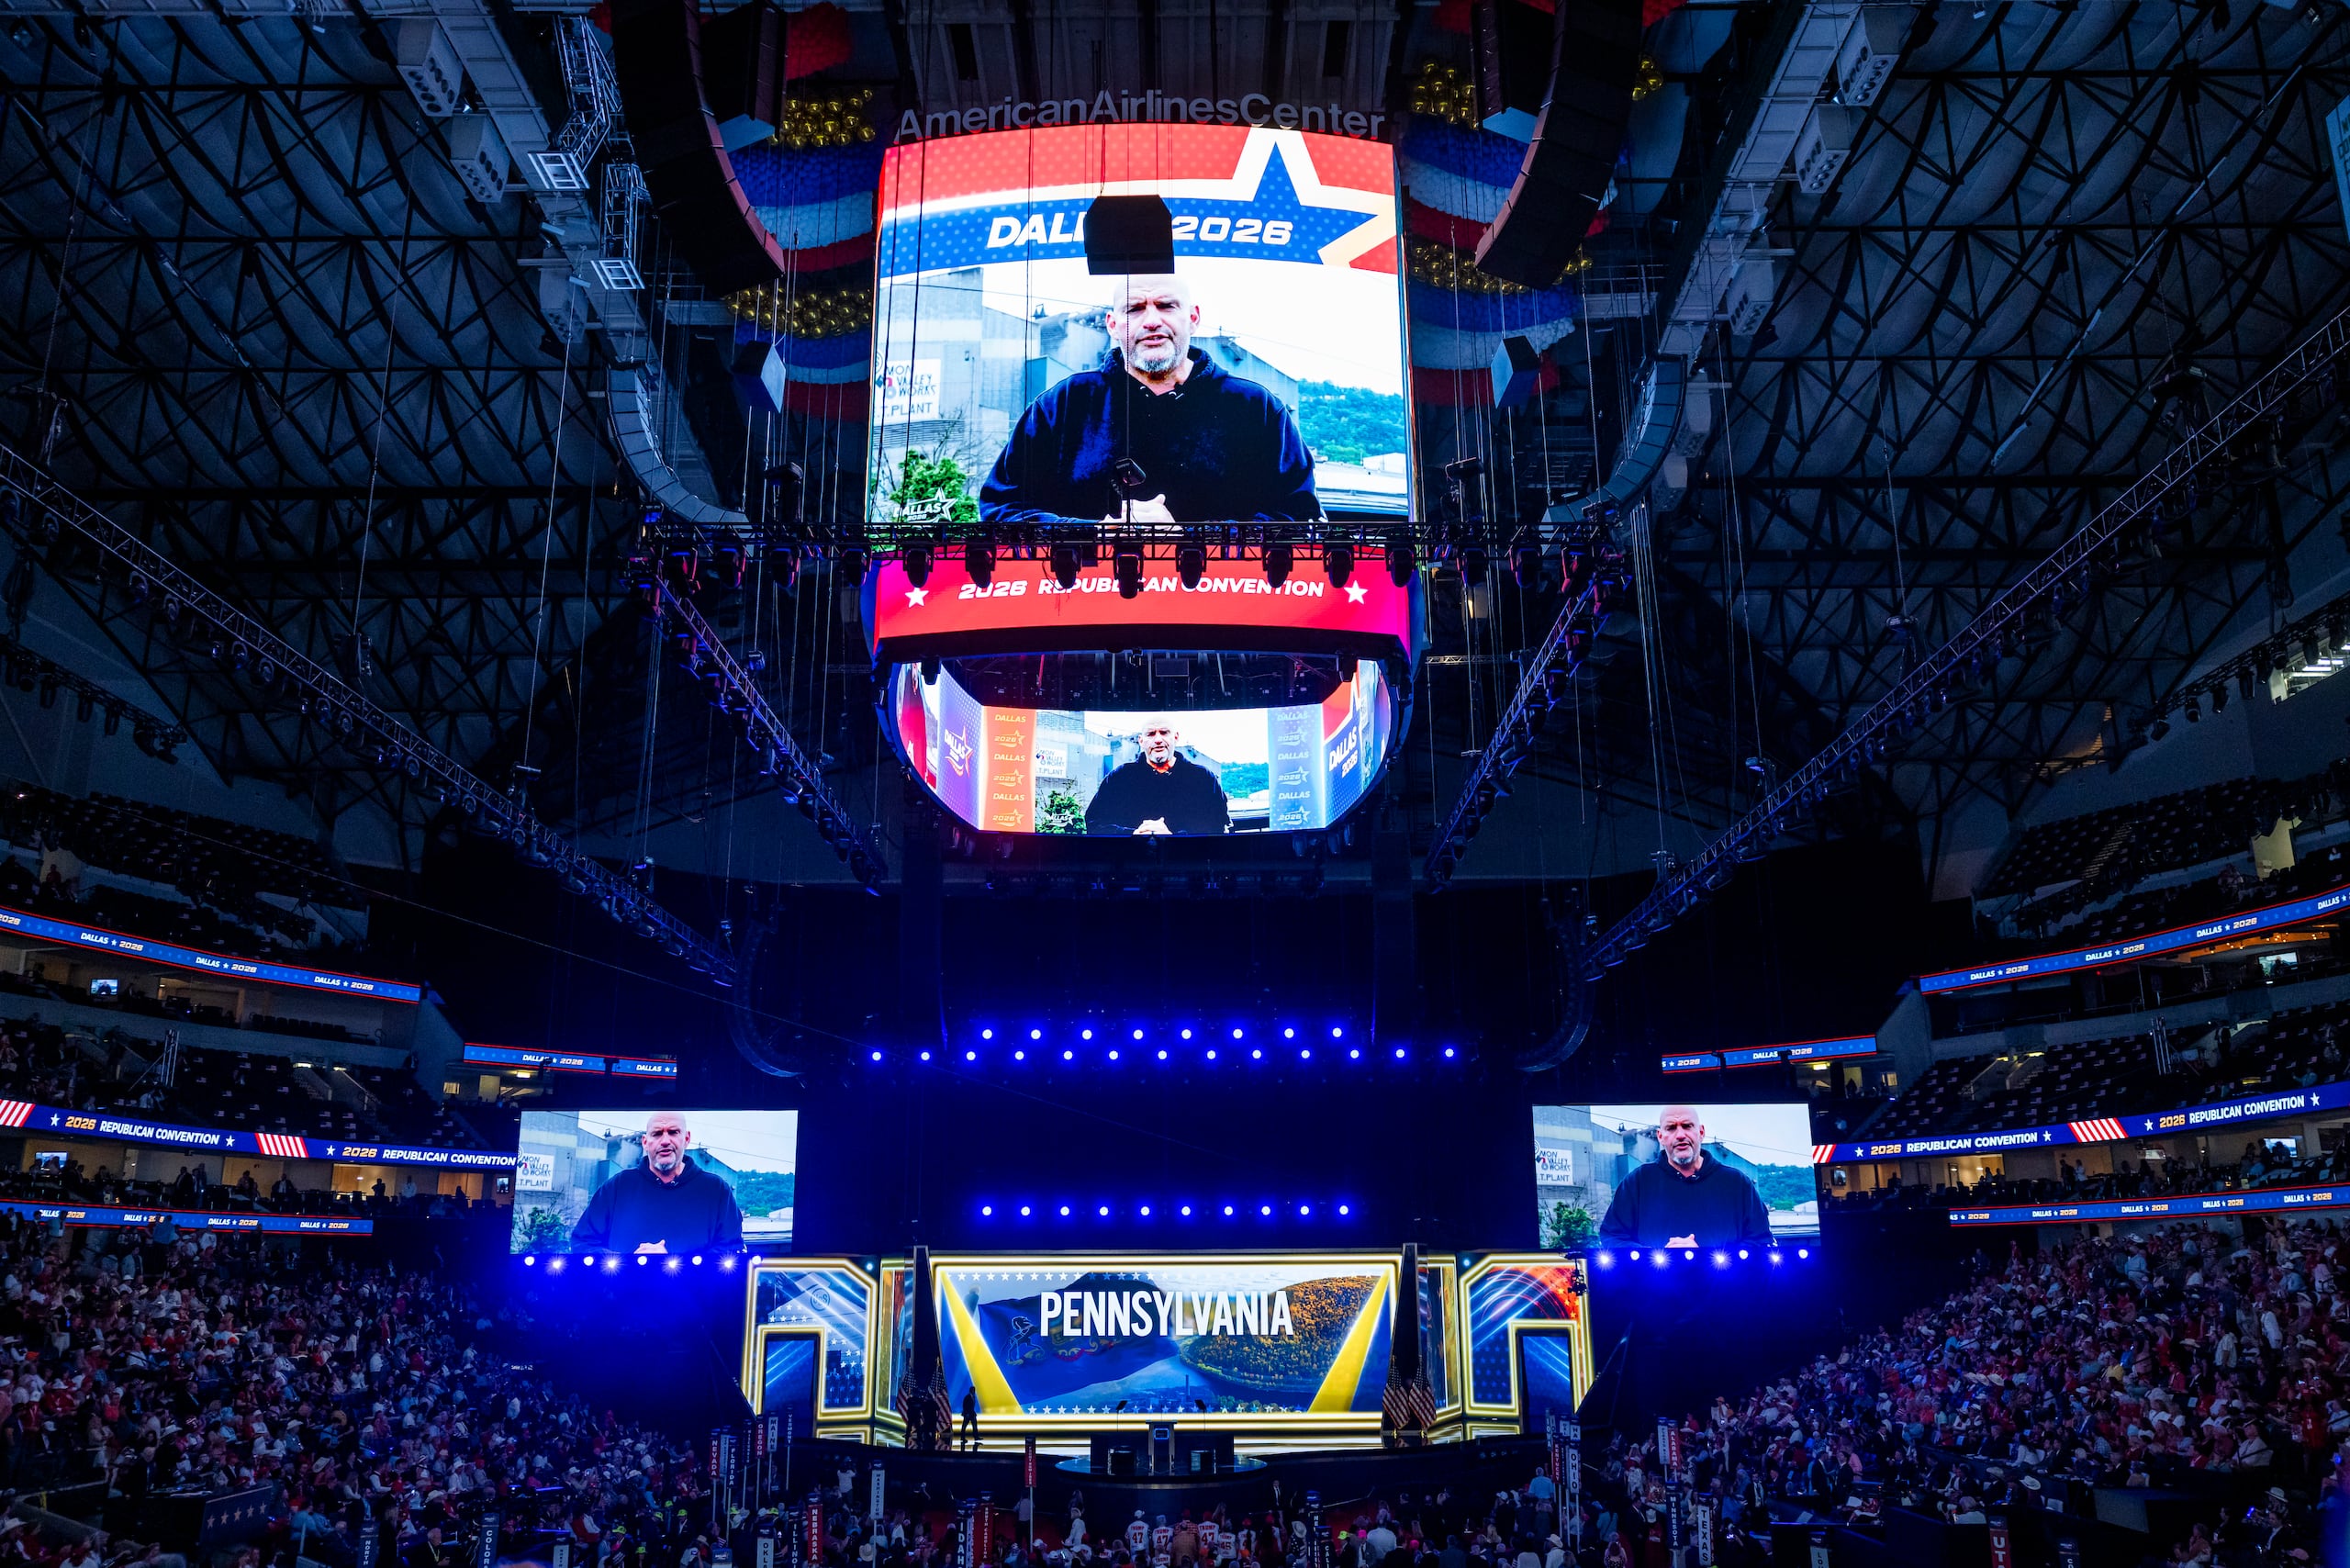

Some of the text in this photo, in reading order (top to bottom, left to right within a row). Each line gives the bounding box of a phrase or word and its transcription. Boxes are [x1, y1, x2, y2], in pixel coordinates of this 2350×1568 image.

[987, 211, 1292, 249] DALL 2026
[958, 580, 1028, 599] 2026
[1038, 577, 1178, 595] REPUBLAN
[994, 714, 1027, 723] DALLAS
[1278, 751, 1310, 760] DALLAS
[1328, 725, 1358, 772] DALLAS
[993, 754, 1026, 762] DALLAS
[992, 793, 1025, 801] DALLAS
[1278, 790, 1311, 801] DALLAS
[2317, 896, 2340, 910] DALLAS
[2197, 918, 2257, 937] DALLAS 2026
[81, 933, 143, 952] DALLAS 2026
[2086, 944, 2144, 961] DALLAS 2026
[196, 957, 257, 973] DALLAS 2026
[1970, 965, 2029, 980] DALLAS 2026
[314, 976, 374, 991] DALLAS 2026
[1677, 1058, 1700, 1067] 2026
[1753, 1051, 1778, 1059] DALLAS
[2159, 1094, 2305, 1128] 2026 REPUBLICAN CONVENTION
[65, 1116, 219, 1145] 2026 REPUBLICAN CONVENTION
[1870, 1131, 2038, 1156] 2026 REPUBLICAN CONVENTION
[341, 1147, 517, 1167] 2026 REPUBLICAN CONVENTION
[2284, 1194, 2304, 1203] DALLAS
[2121, 1205, 2143, 1214] DALLAS
[124, 1214, 142, 1223] DALLAS
[208, 1217, 230, 1226] DALLAS
[300, 1220, 320, 1228] DALLAS
[1040, 1290, 1293, 1337] PENNSYLVANIA
[711, 1439, 719, 1476] NEVADA
[1670, 1496, 1679, 1547] MINNESOTA
[957, 1521, 966, 1568] IDAH
[1132, 1531, 1144, 1544] 47
[1201, 1532, 1215, 1546] 47
